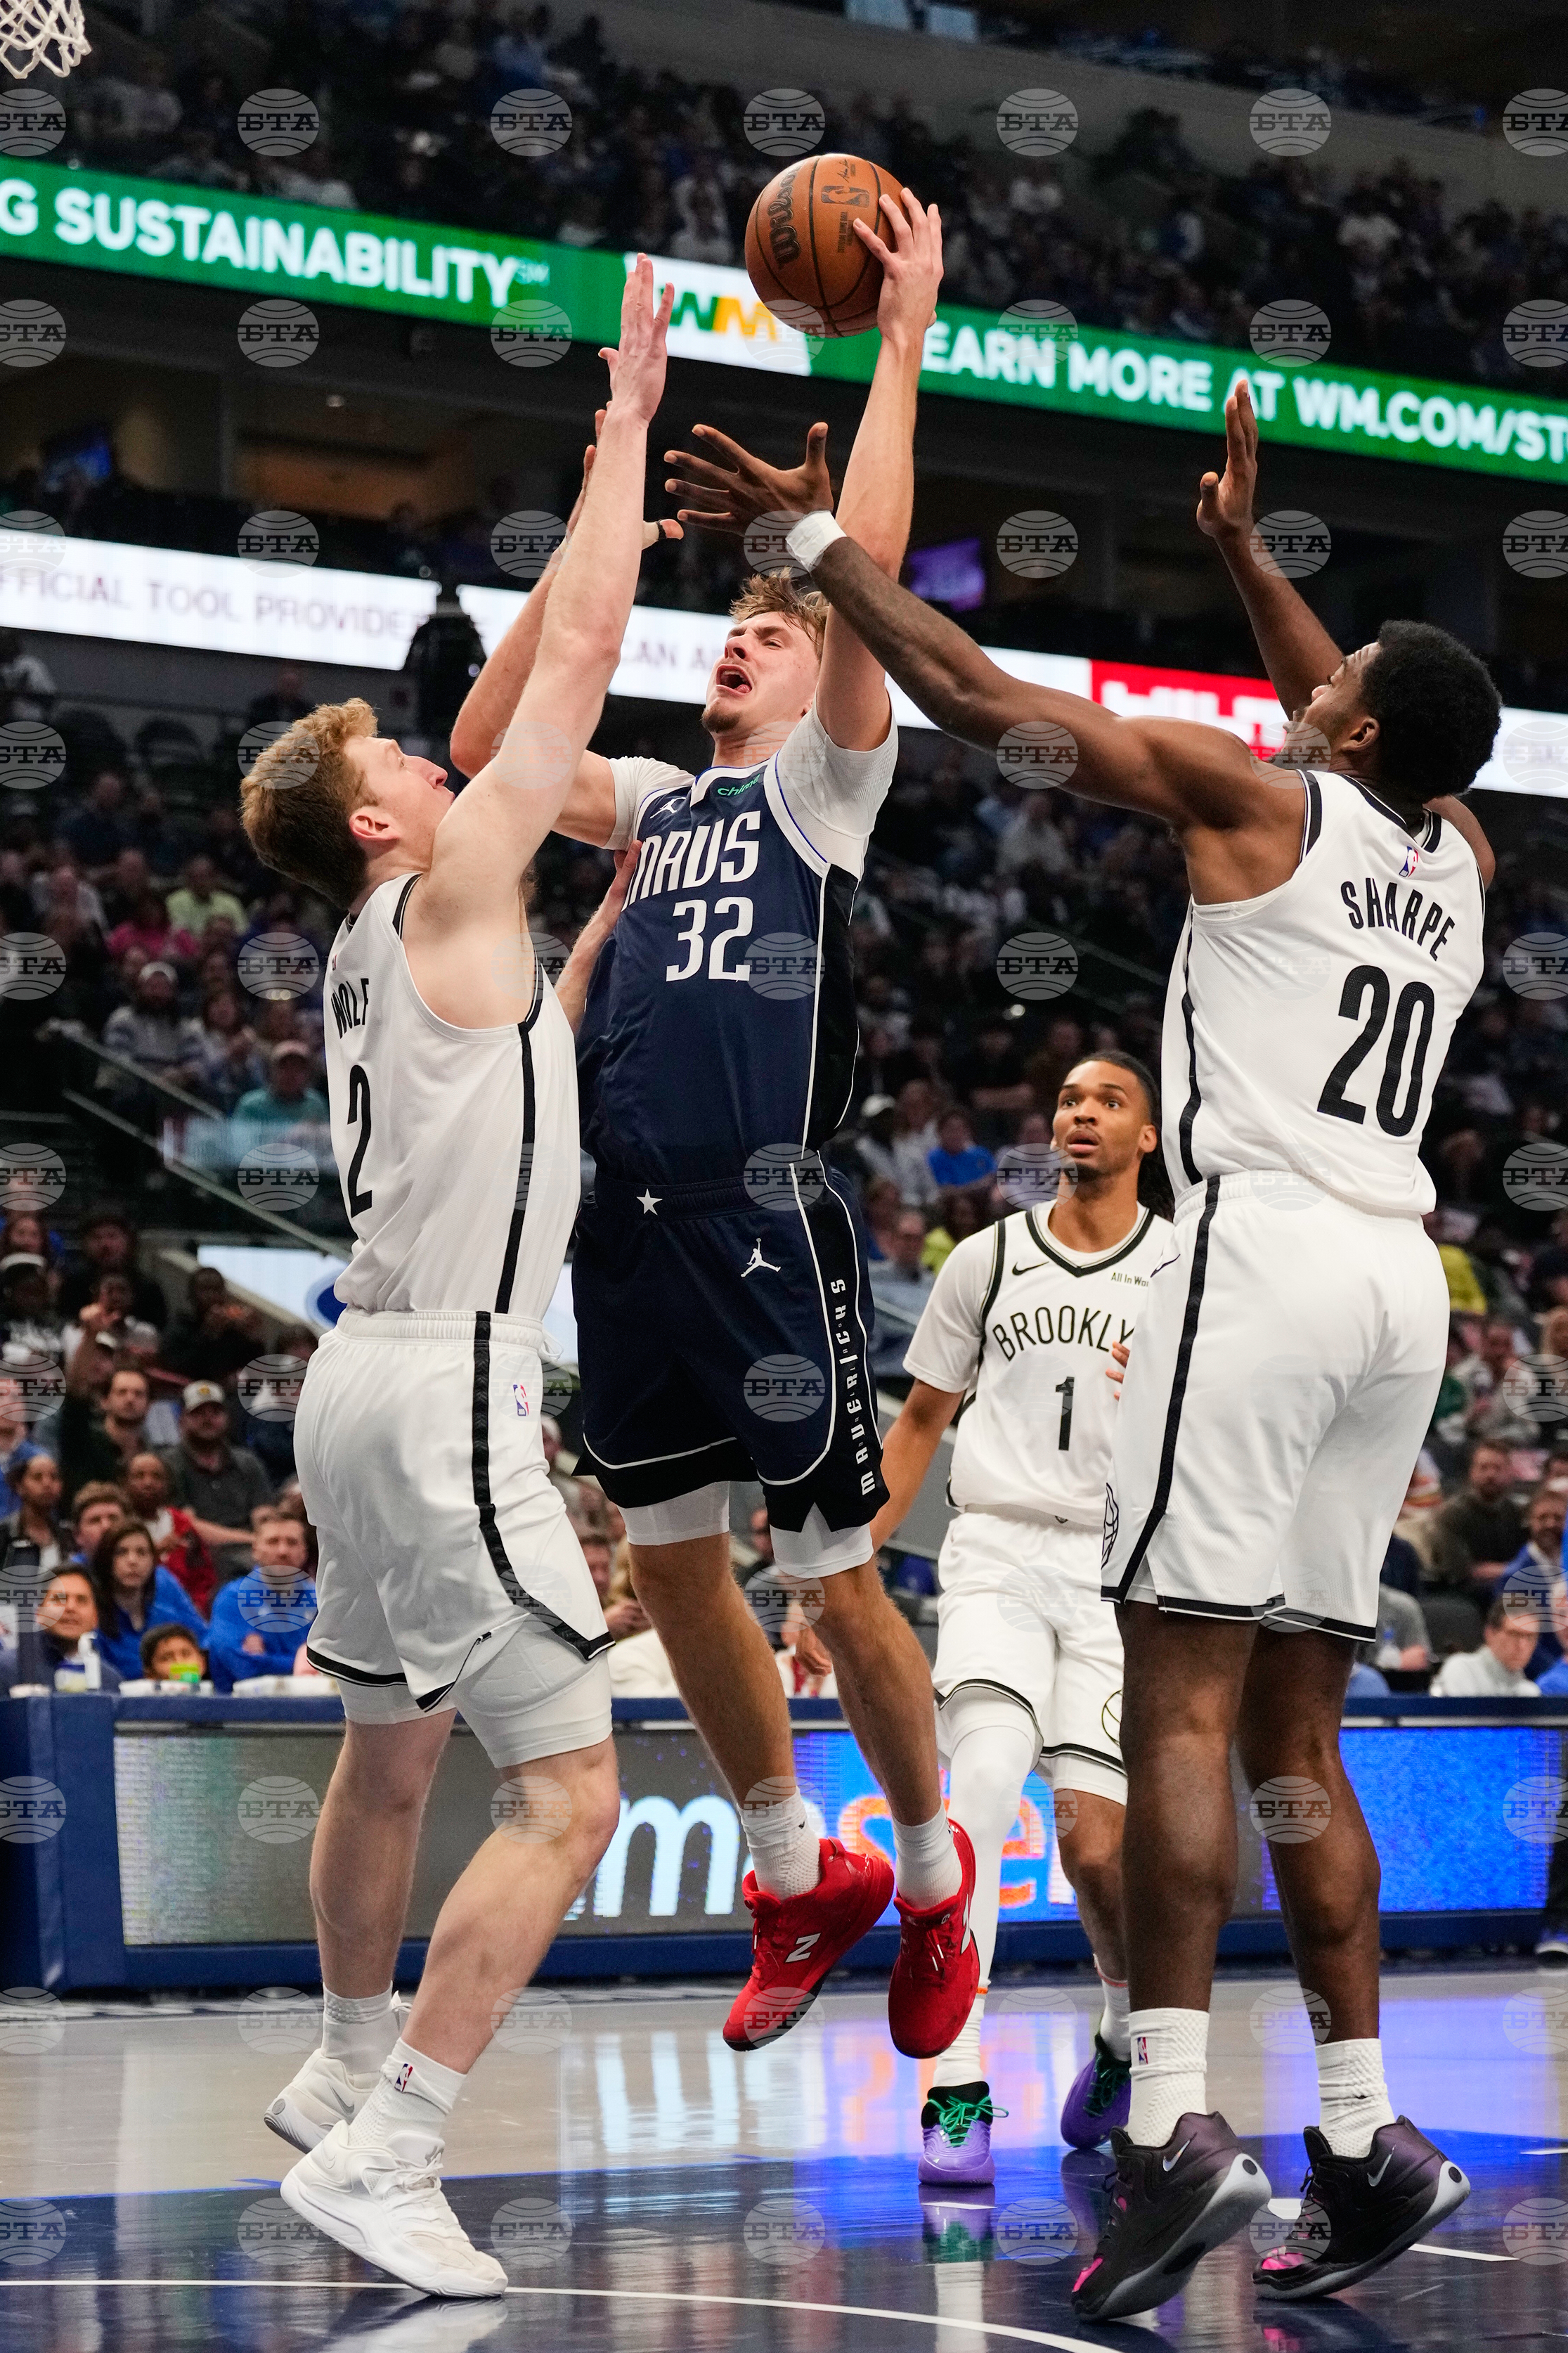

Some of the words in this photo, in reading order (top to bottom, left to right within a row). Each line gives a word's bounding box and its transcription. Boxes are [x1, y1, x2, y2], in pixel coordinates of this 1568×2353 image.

[54, 187, 519, 308] SUSTAINABILITY
[1068, 341, 1213, 413] MORE
[1223, 368, 1285, 422] AT
[146, 578, 242, 623] TOOL
[717, 773, 760, 796] chime
[666, 896, 753, 982] 32
[1340, 877, 1456, 962] SHARPE
[331, 978, 369, 1039] WOLF
[1316, 965, 1435, 1137] 20
[346, 1064, 372, 1218] 2
[1055, 1377, 1075, 1451] 1
